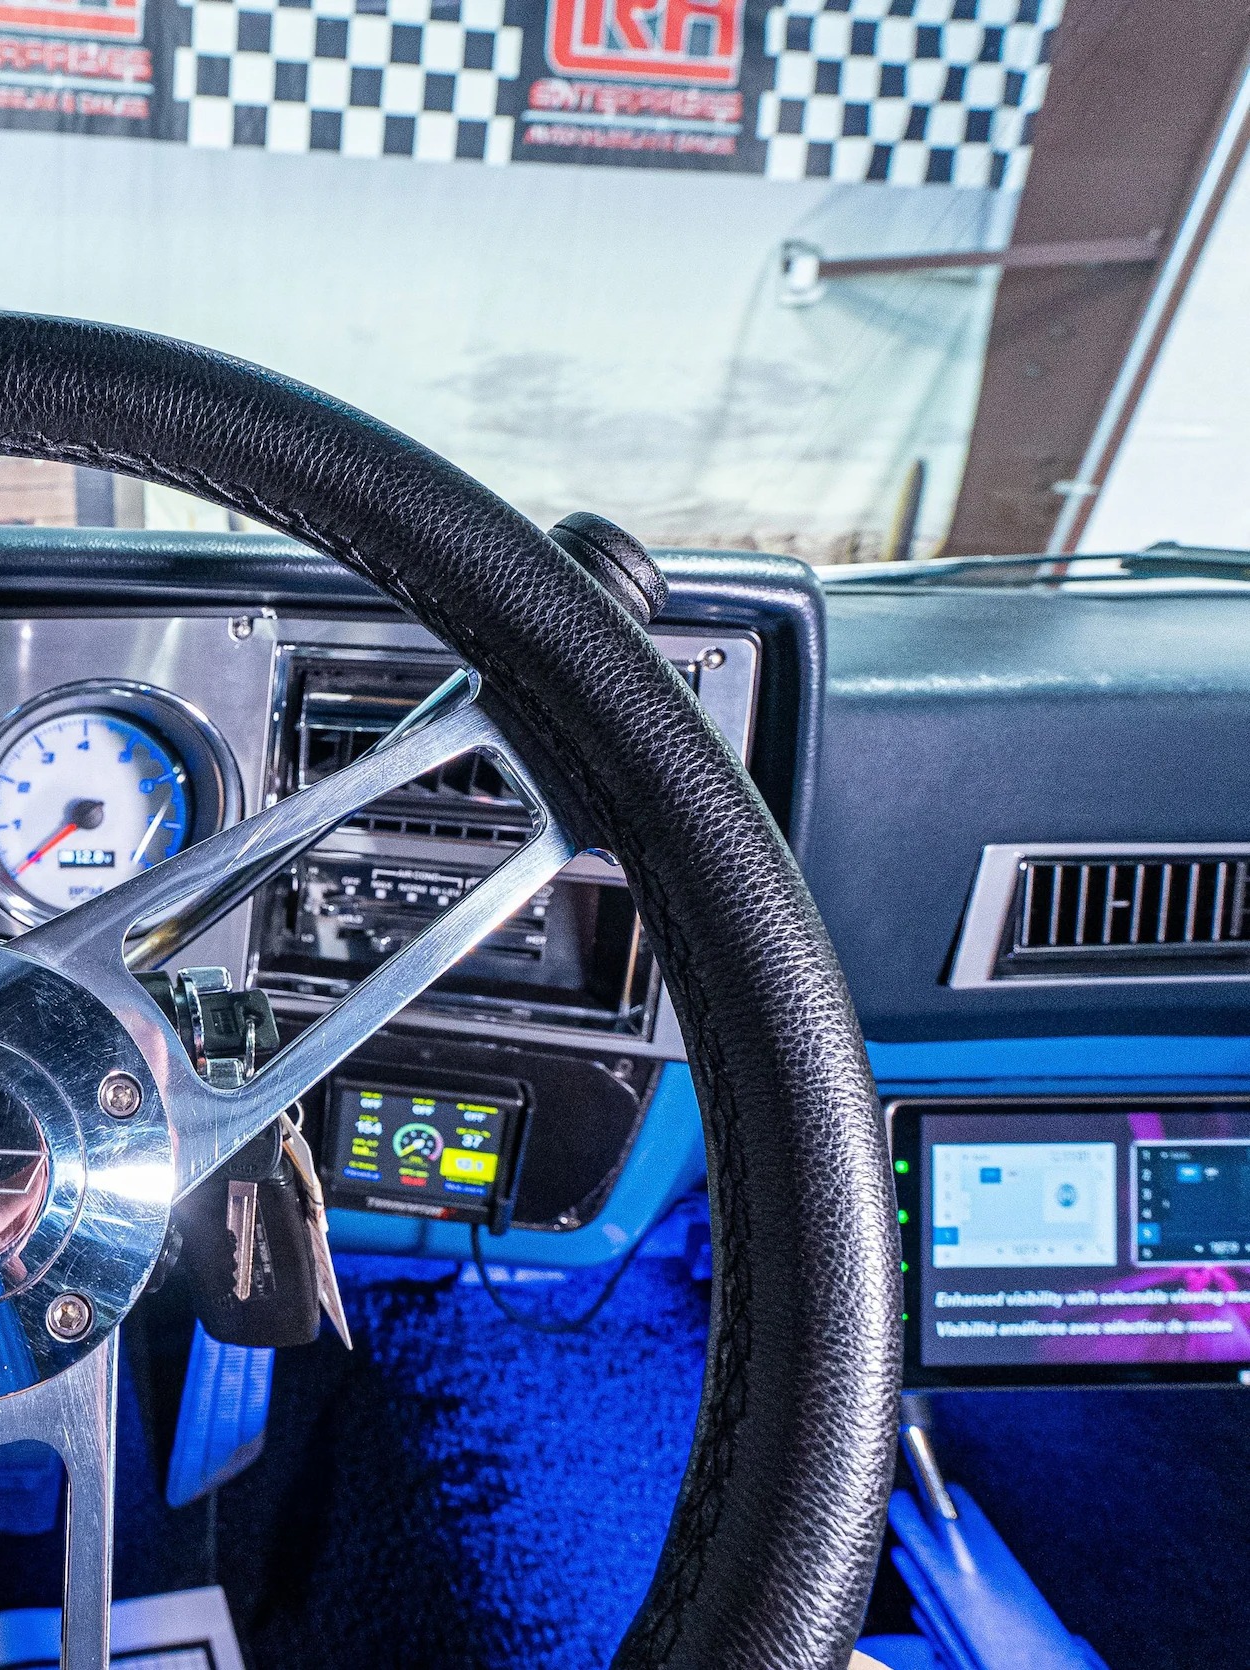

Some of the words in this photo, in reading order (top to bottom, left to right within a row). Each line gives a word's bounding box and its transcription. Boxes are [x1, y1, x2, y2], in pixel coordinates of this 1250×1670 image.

[934, 1290, 1006, 1308] Enhanced
[1005, 1290, 1064, 1309] visibility
[1064, 1289, 1098, 1306] with
